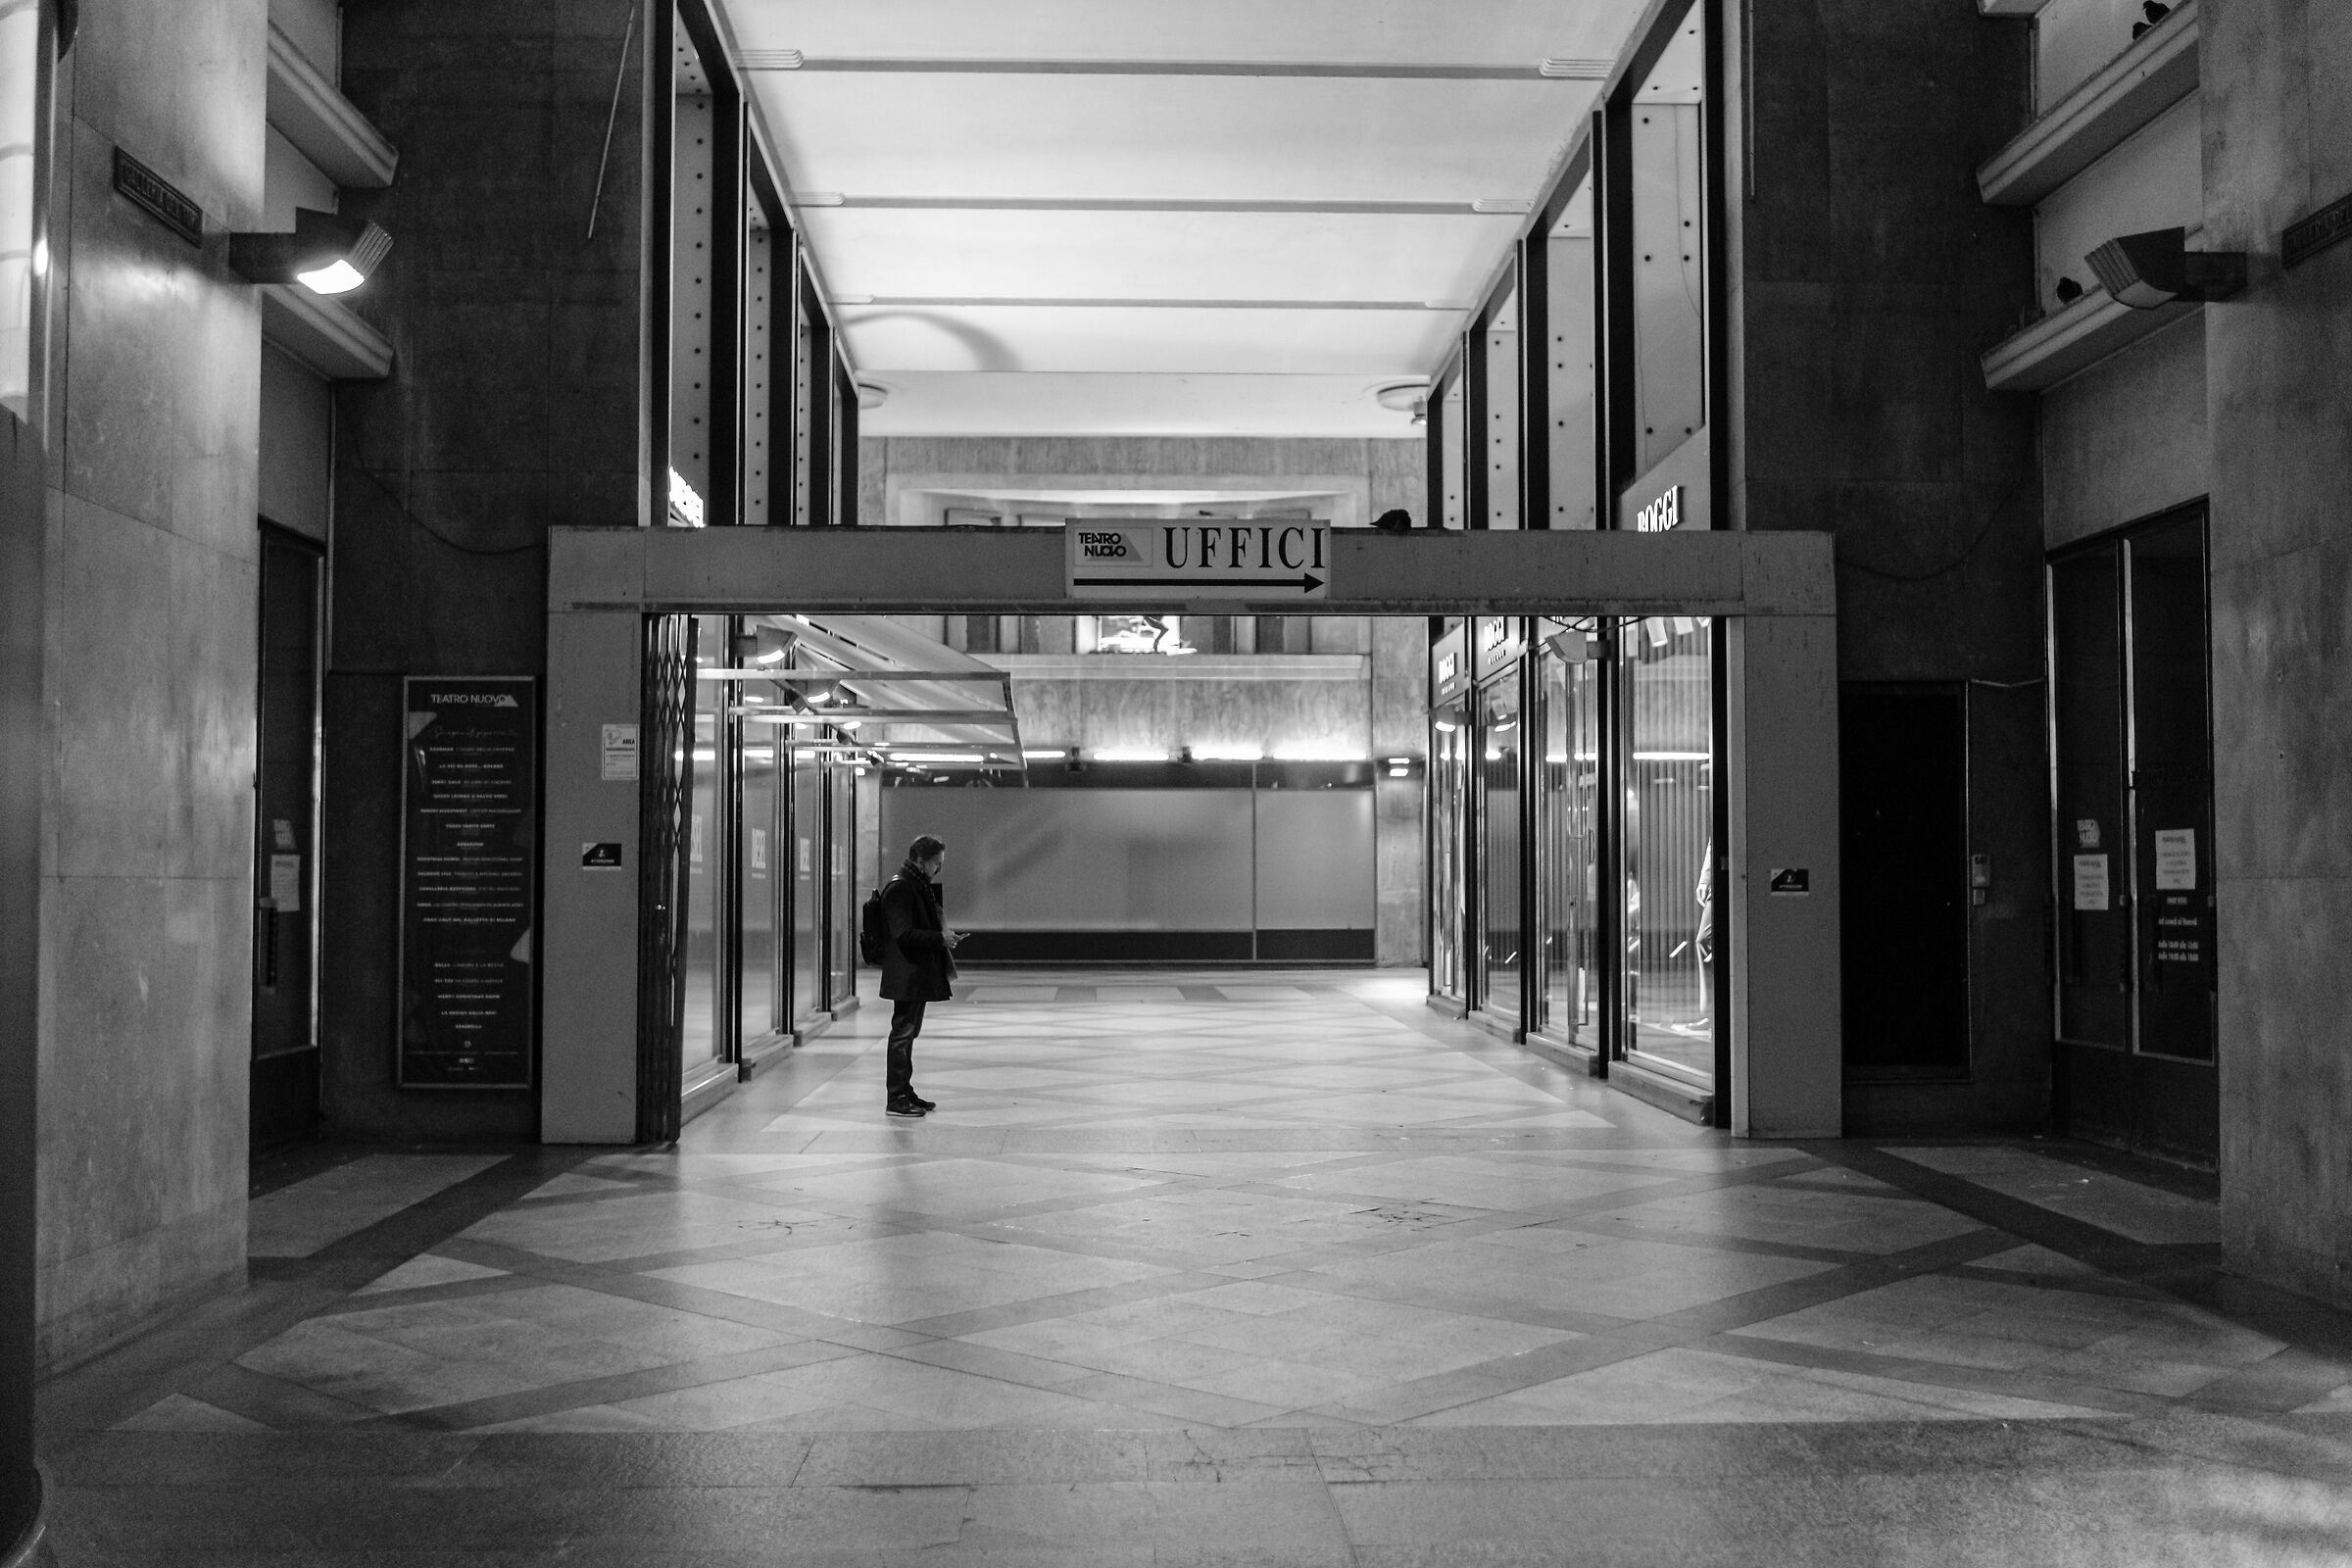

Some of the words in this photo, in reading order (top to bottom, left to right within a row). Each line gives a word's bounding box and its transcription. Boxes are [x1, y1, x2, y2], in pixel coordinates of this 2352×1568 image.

[1079, 532, 1122, 545] TEATRO
[1084, 545, 1126, 557] NUOVO
[1163, 526, 1325, 569] UFFICI
[430, 694, 468, 704] TEATRO
[470, 694, 508, 704] NUOVO
